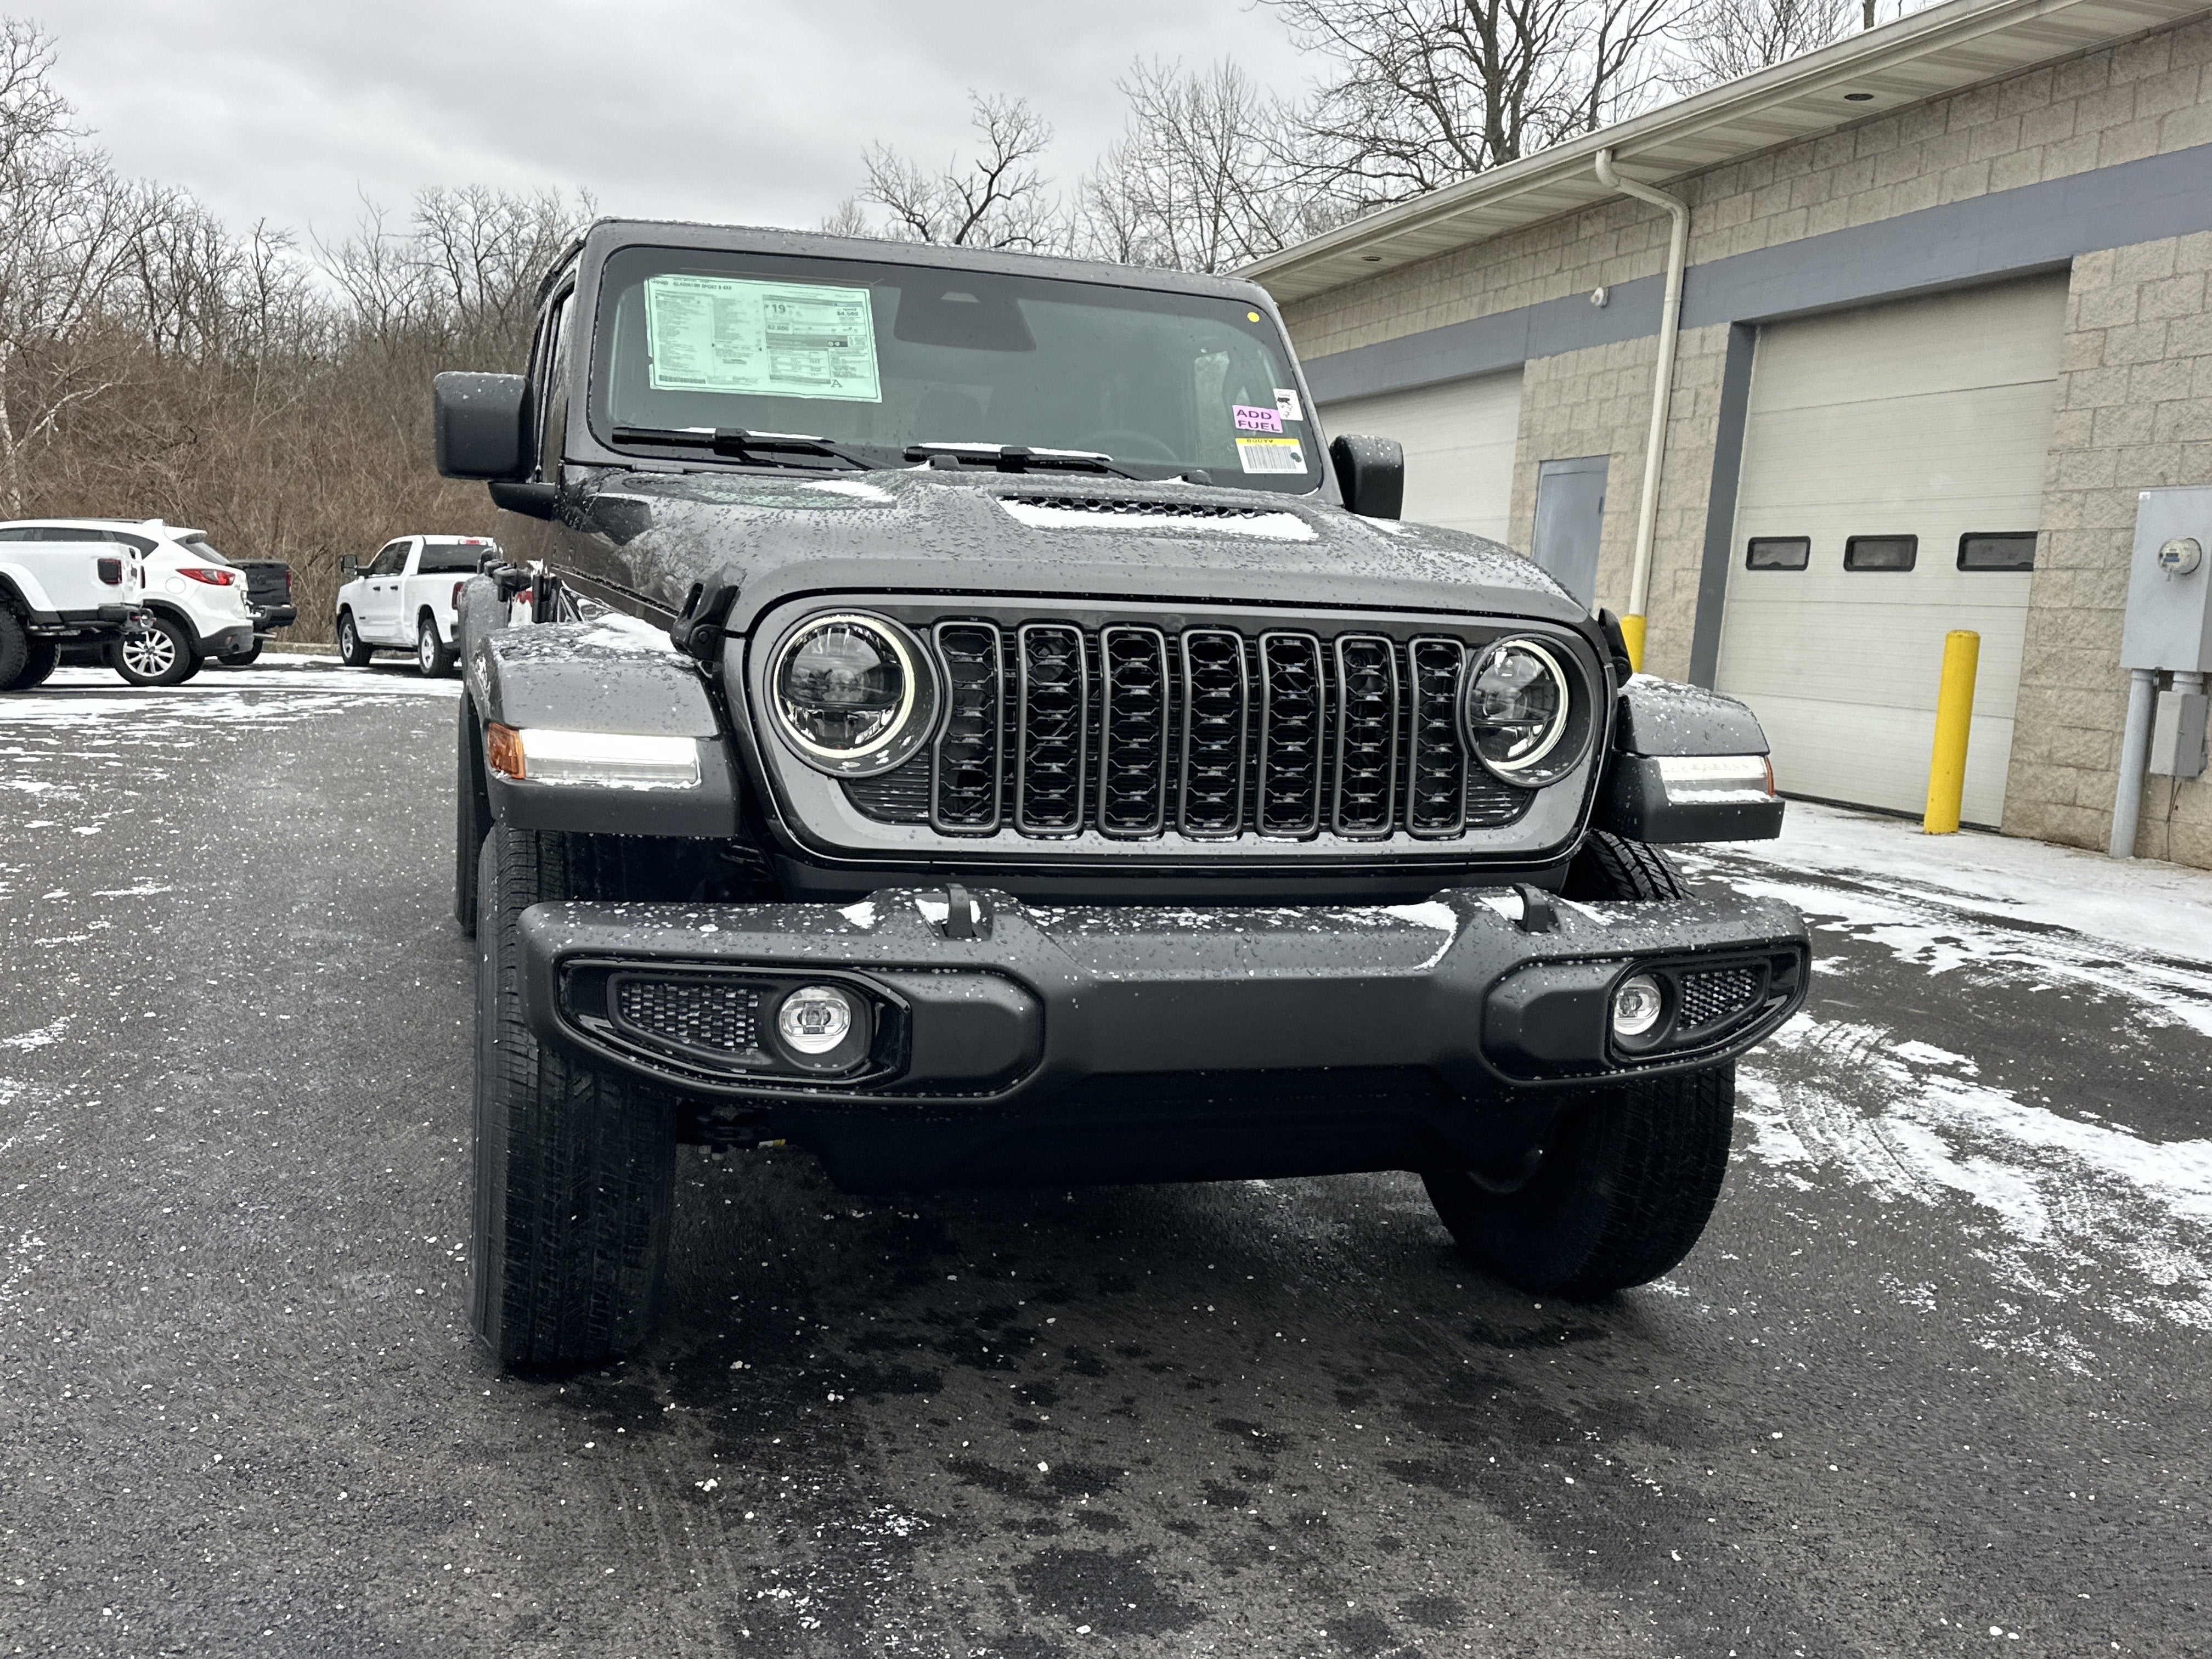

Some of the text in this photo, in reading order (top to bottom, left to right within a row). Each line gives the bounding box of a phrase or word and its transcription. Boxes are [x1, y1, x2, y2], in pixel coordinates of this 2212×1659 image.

[771, 304, 786, 313] 19
[1237, 409, 1272, 419] ADD
[1238, 420, 1280, 431] FUEL
